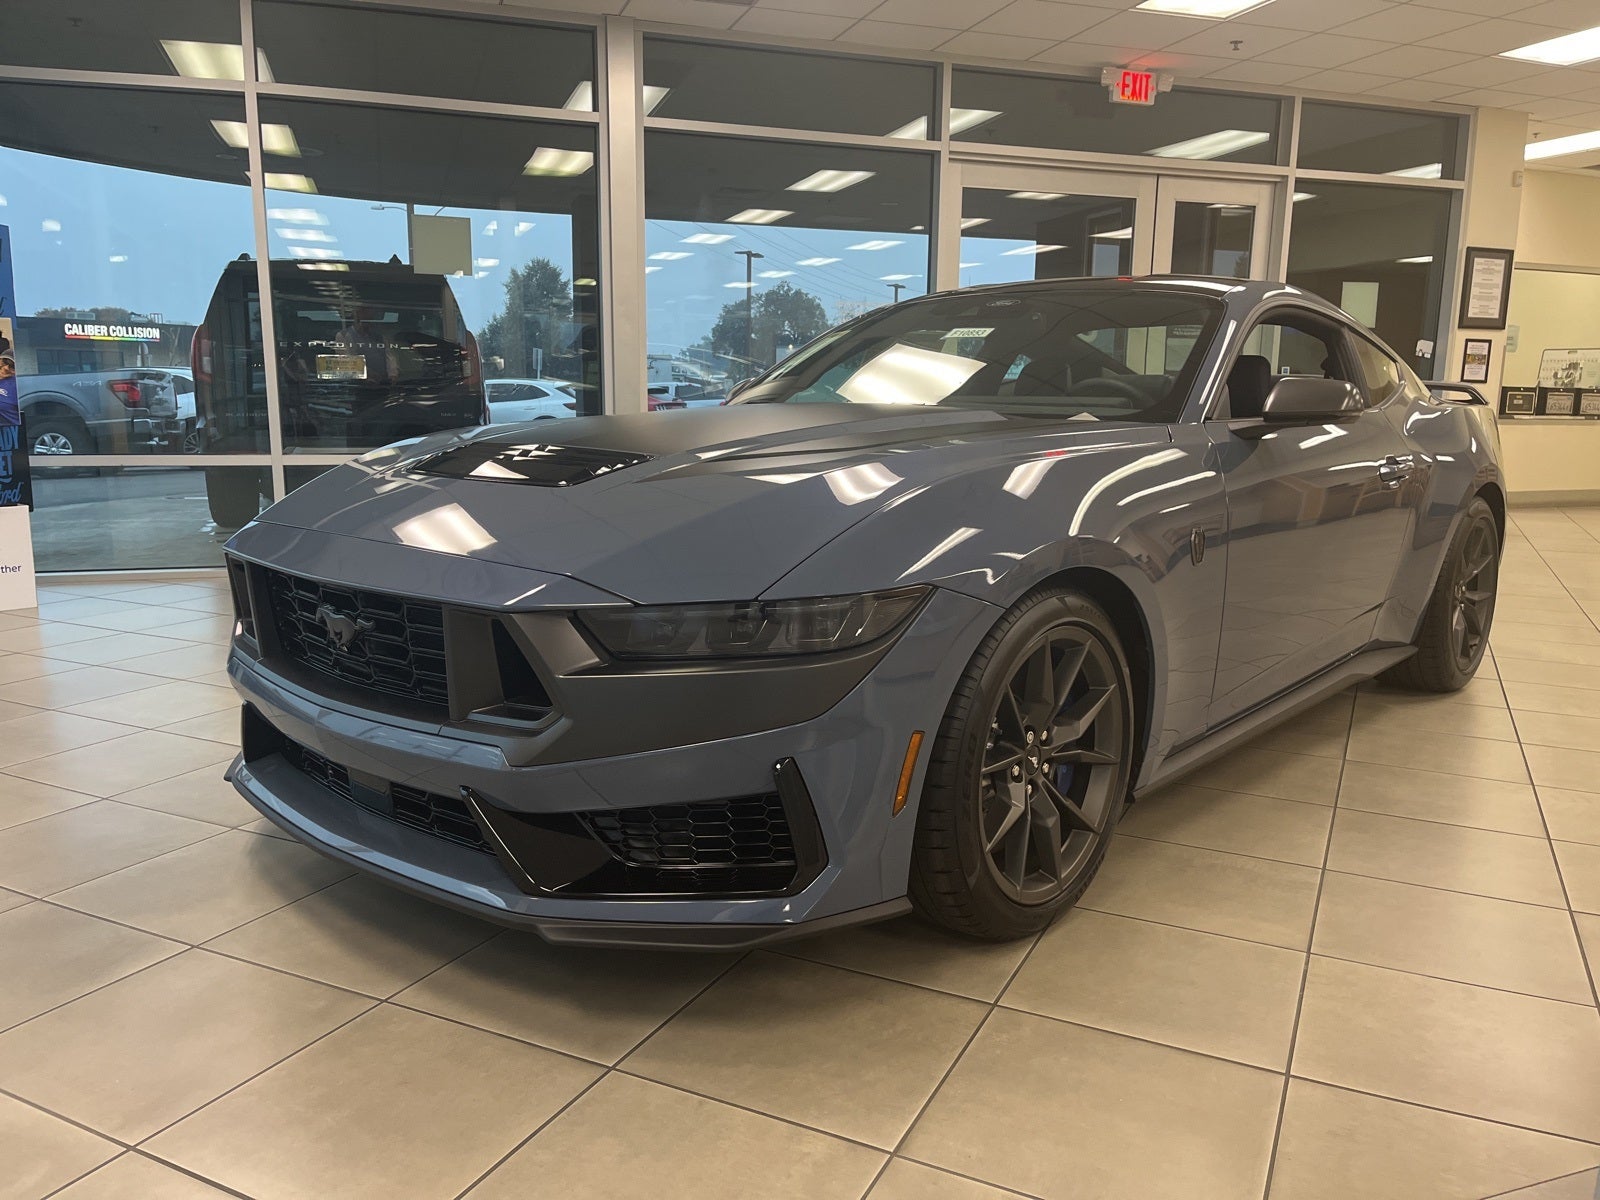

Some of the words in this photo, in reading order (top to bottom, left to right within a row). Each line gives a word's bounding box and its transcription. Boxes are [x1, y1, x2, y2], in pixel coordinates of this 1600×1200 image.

[1121, 71, 1151, 102] EXIT
[64, 323, 108, 336] CALIBER
[109, 325, 160, 339] COLLISION
